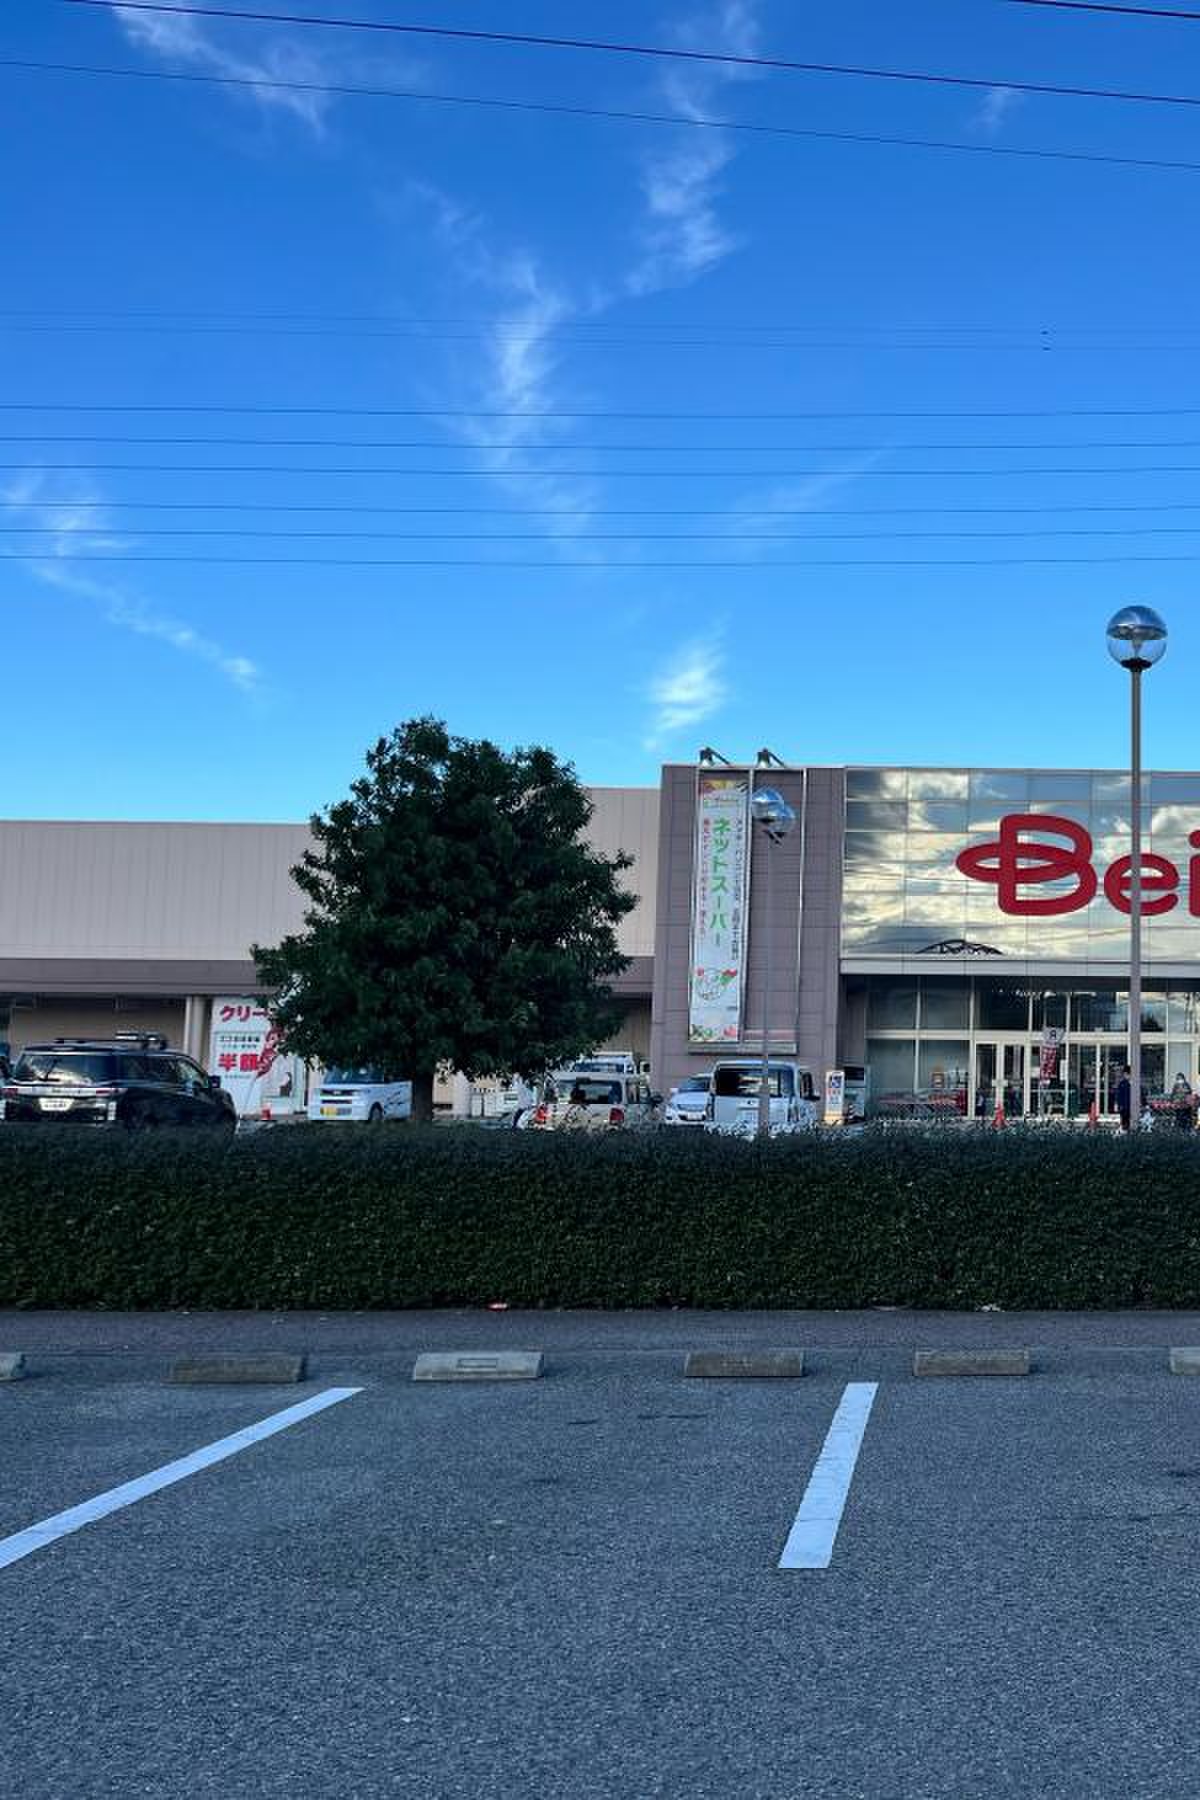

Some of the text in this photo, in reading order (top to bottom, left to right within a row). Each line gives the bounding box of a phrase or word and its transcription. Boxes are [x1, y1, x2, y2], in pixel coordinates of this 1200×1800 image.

[710, 818, 731, 947] ネットスーパー
